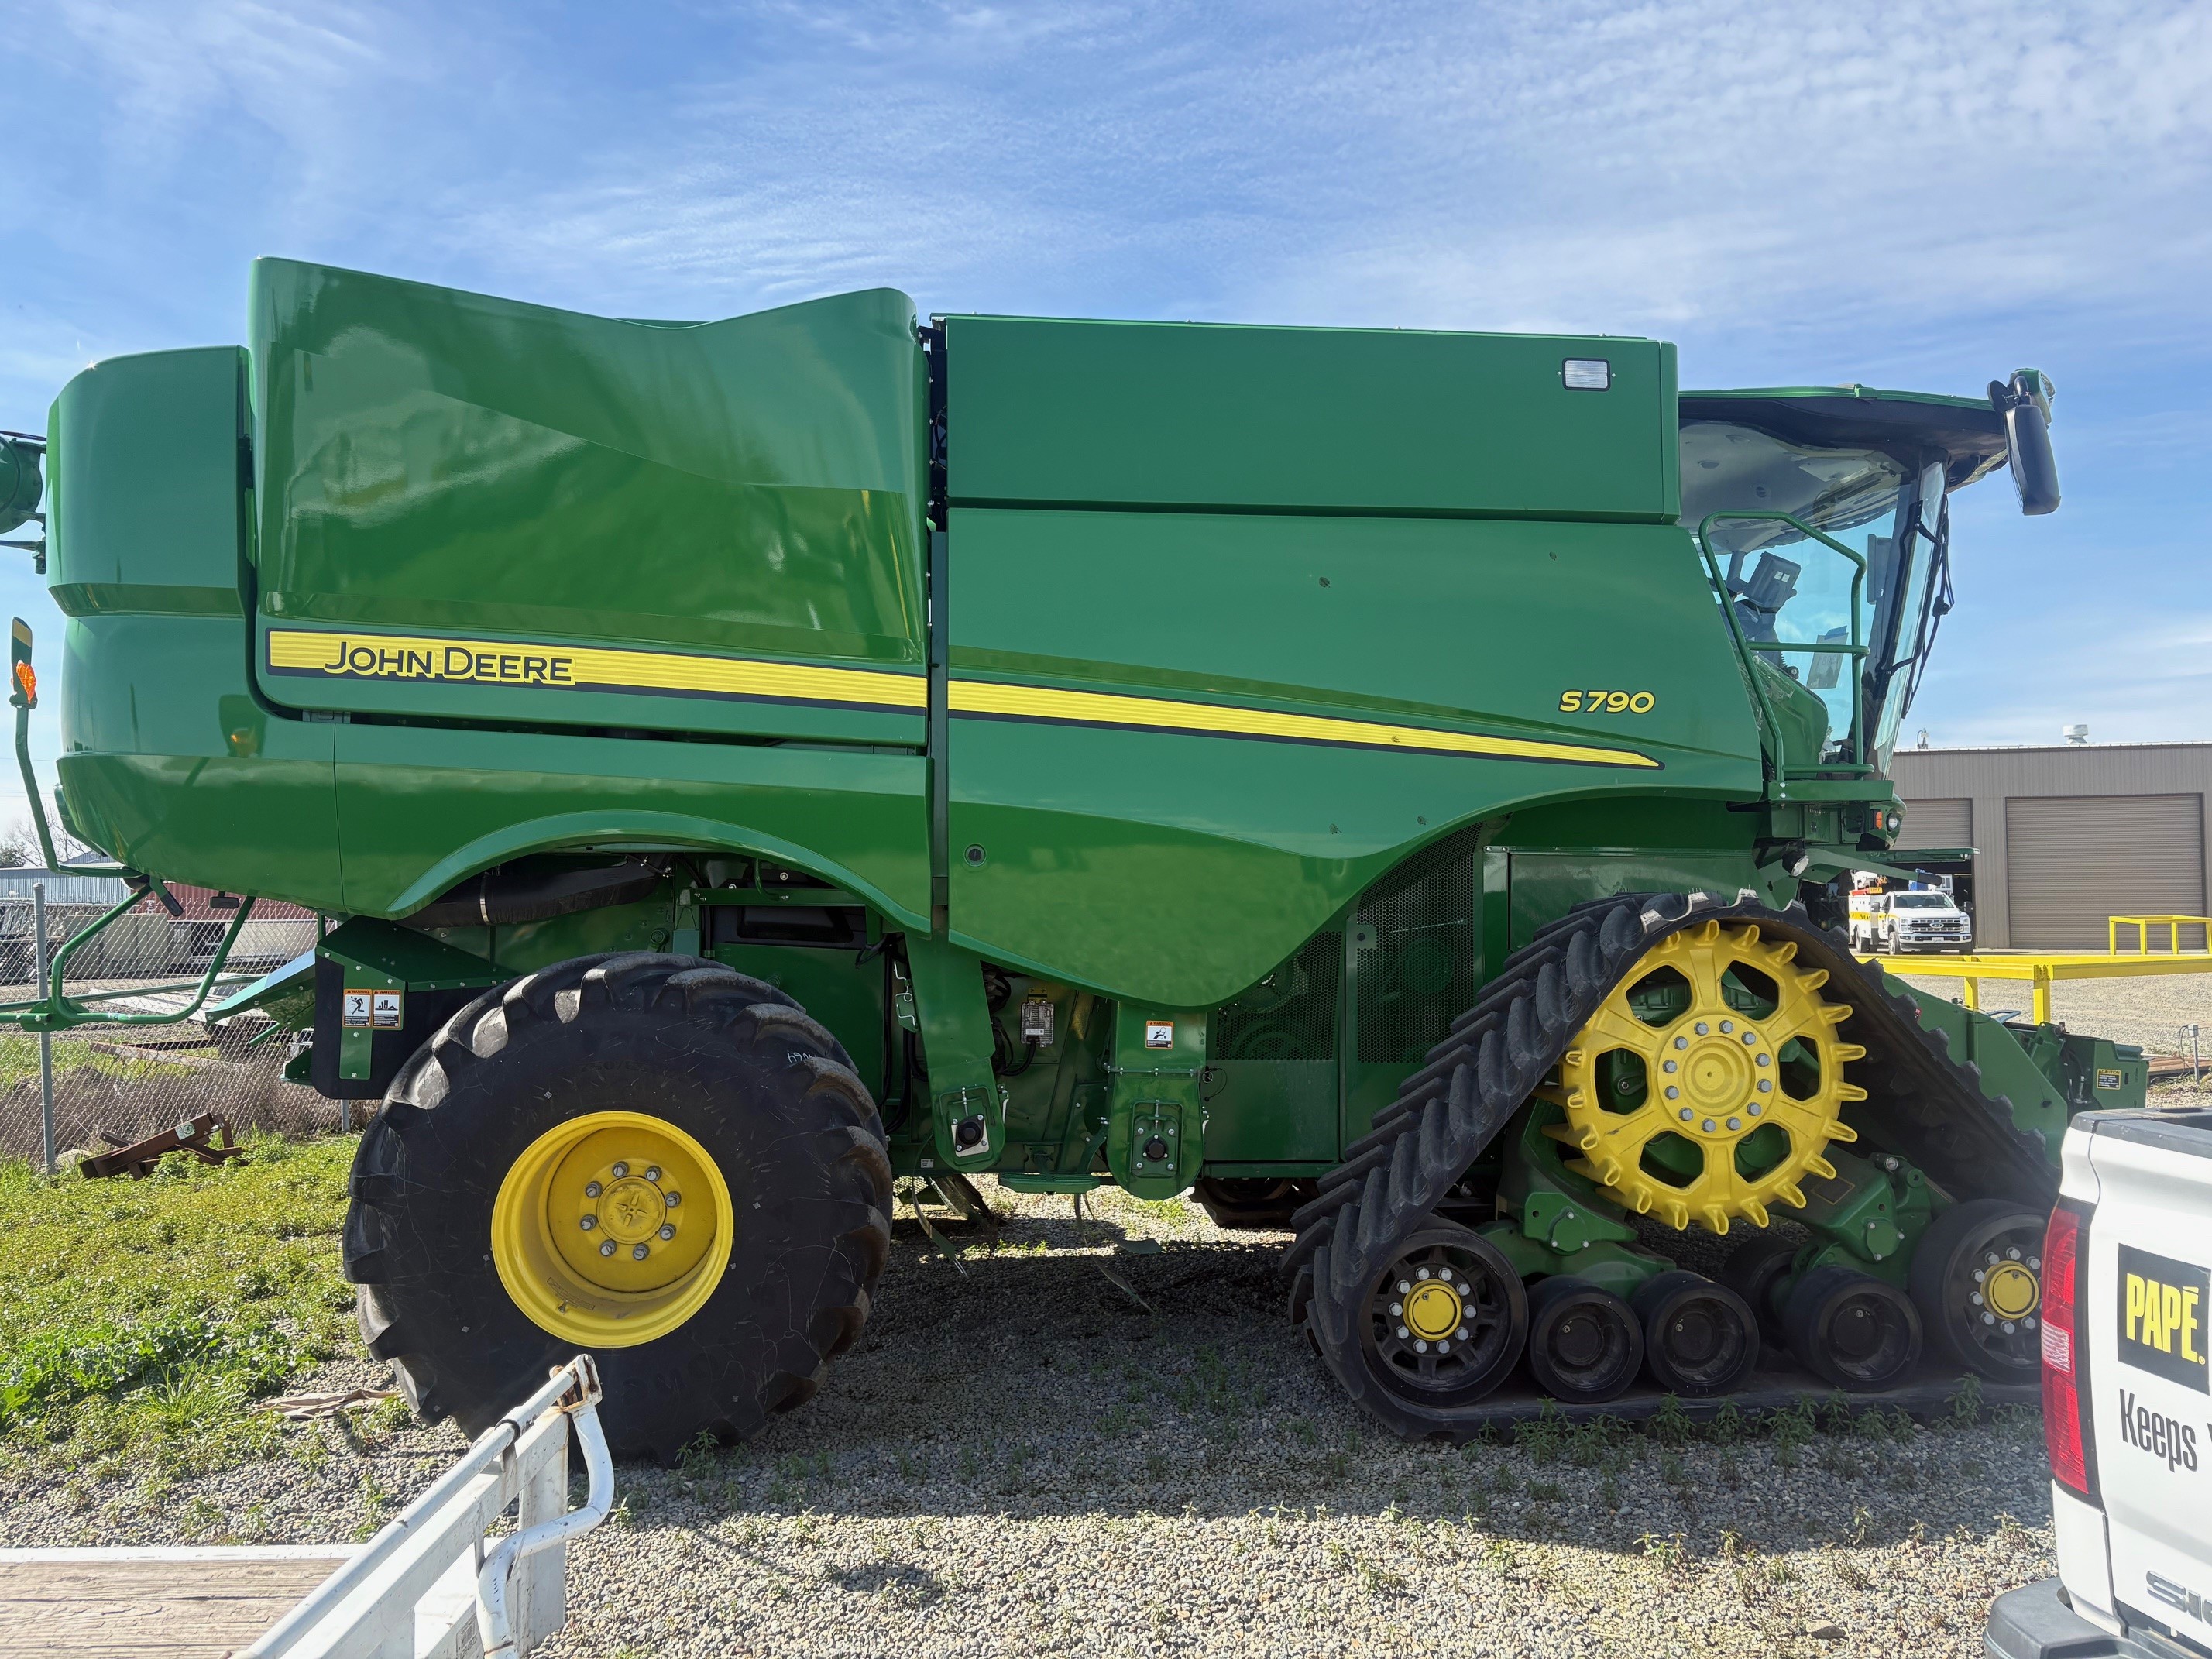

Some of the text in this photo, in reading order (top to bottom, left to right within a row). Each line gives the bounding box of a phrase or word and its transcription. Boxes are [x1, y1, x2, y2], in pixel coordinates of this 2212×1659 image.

[325, 641, 575, 683] JOHN DEERE
[1558, 689, 1656, 714] S790
[2119, 1388, 2198, 1473] Keeps
